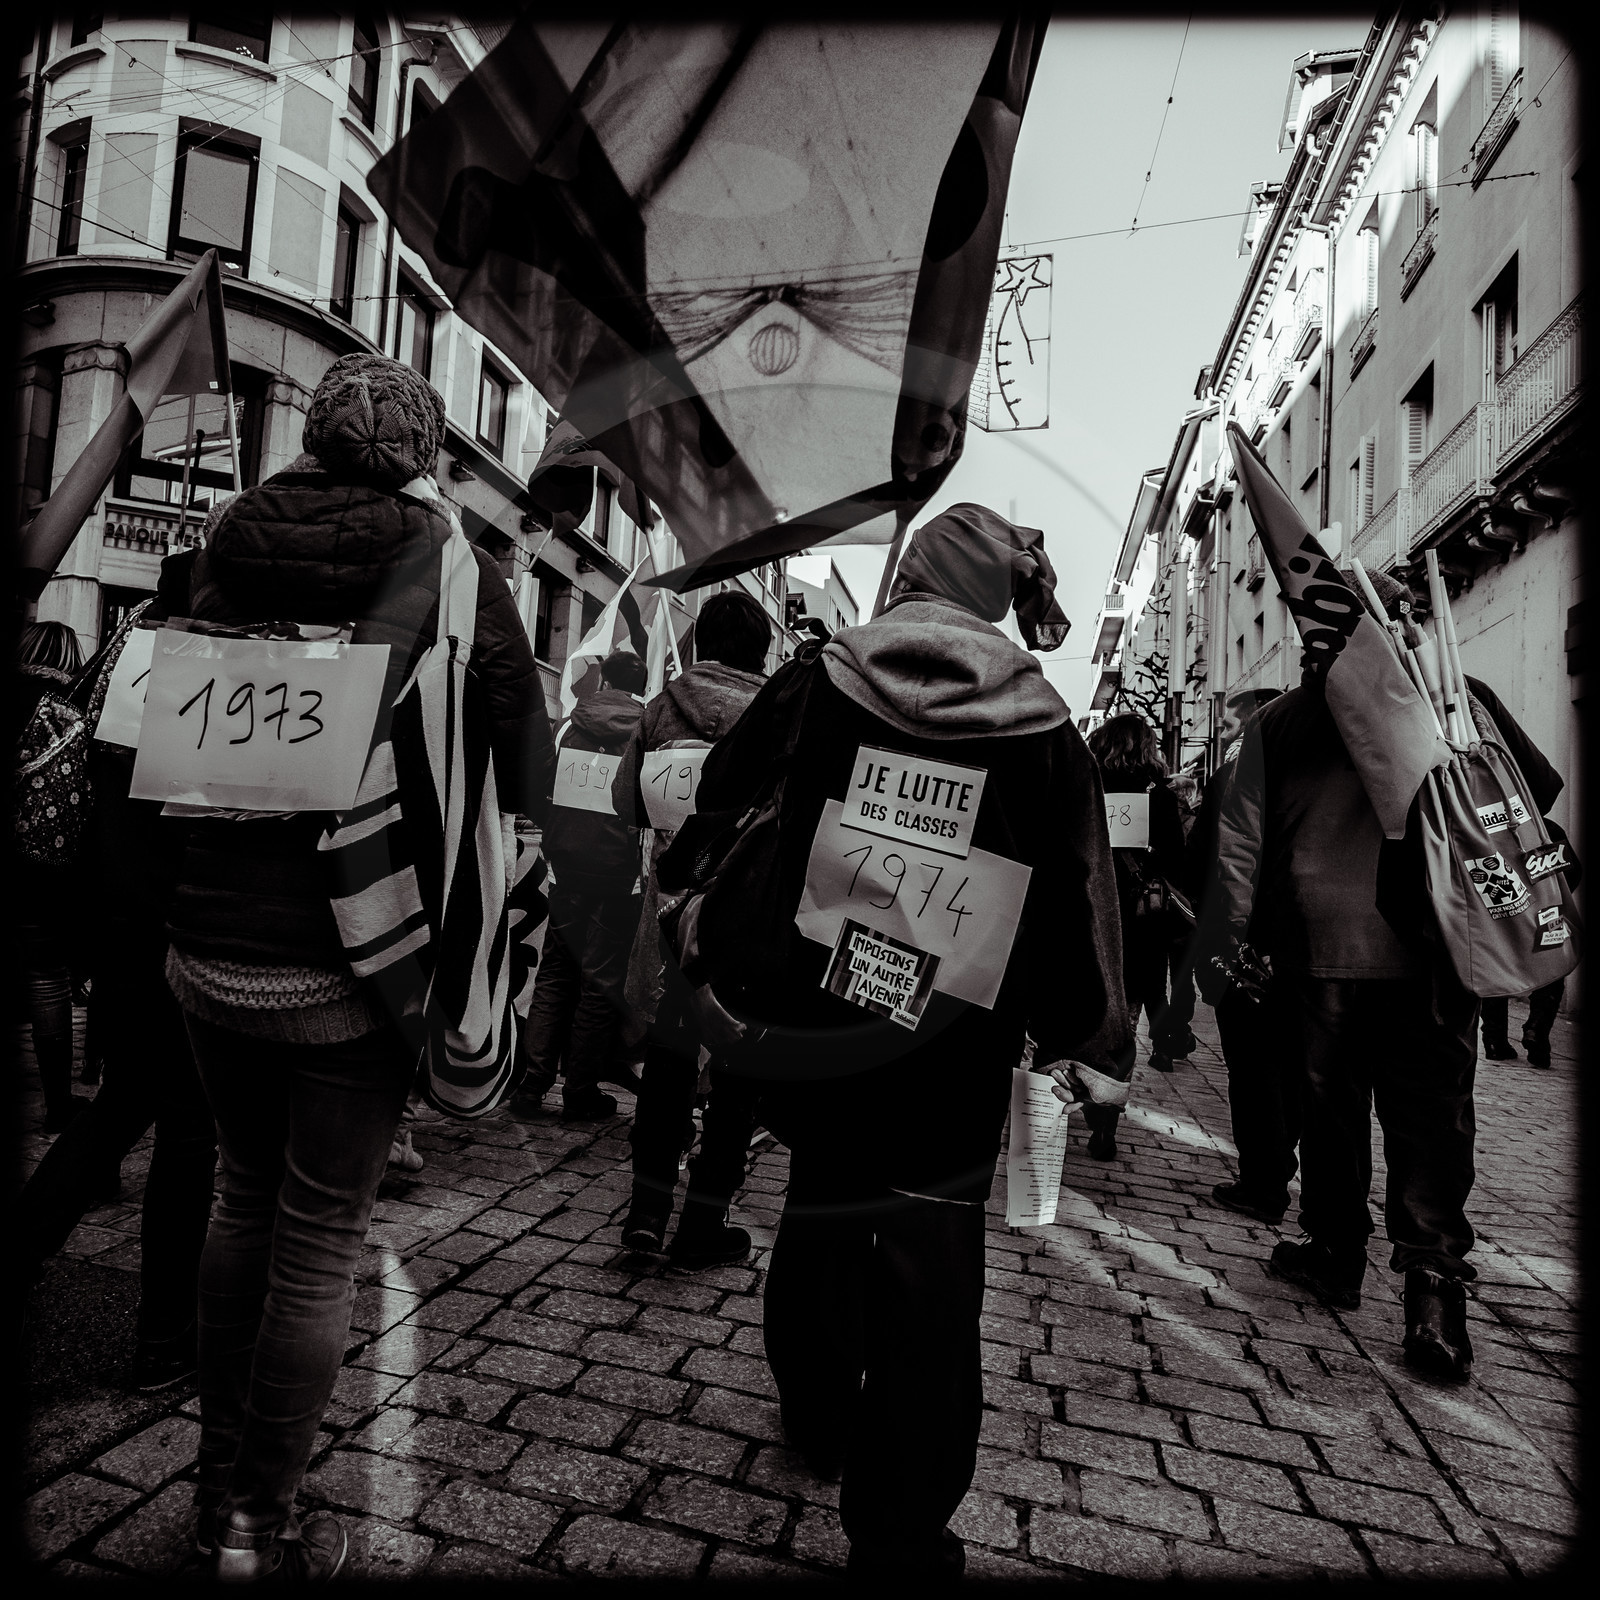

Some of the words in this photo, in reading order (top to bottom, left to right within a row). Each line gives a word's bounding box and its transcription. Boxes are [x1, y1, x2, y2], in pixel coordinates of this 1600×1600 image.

[105, 522, 169, 545] BANQUE
[179, 678, 325, 750] 1973
[857, 763, 889, 794] JE
[897, 768, 974, 813] LUTTE
[860, 800, 887, 823] DES
[894, 809, 959, 840] CLASSES
[843, 844, 973, 938] 1974
[853, 957, 870, 974] UN
[871, 964, 915, 992] AUTRE
